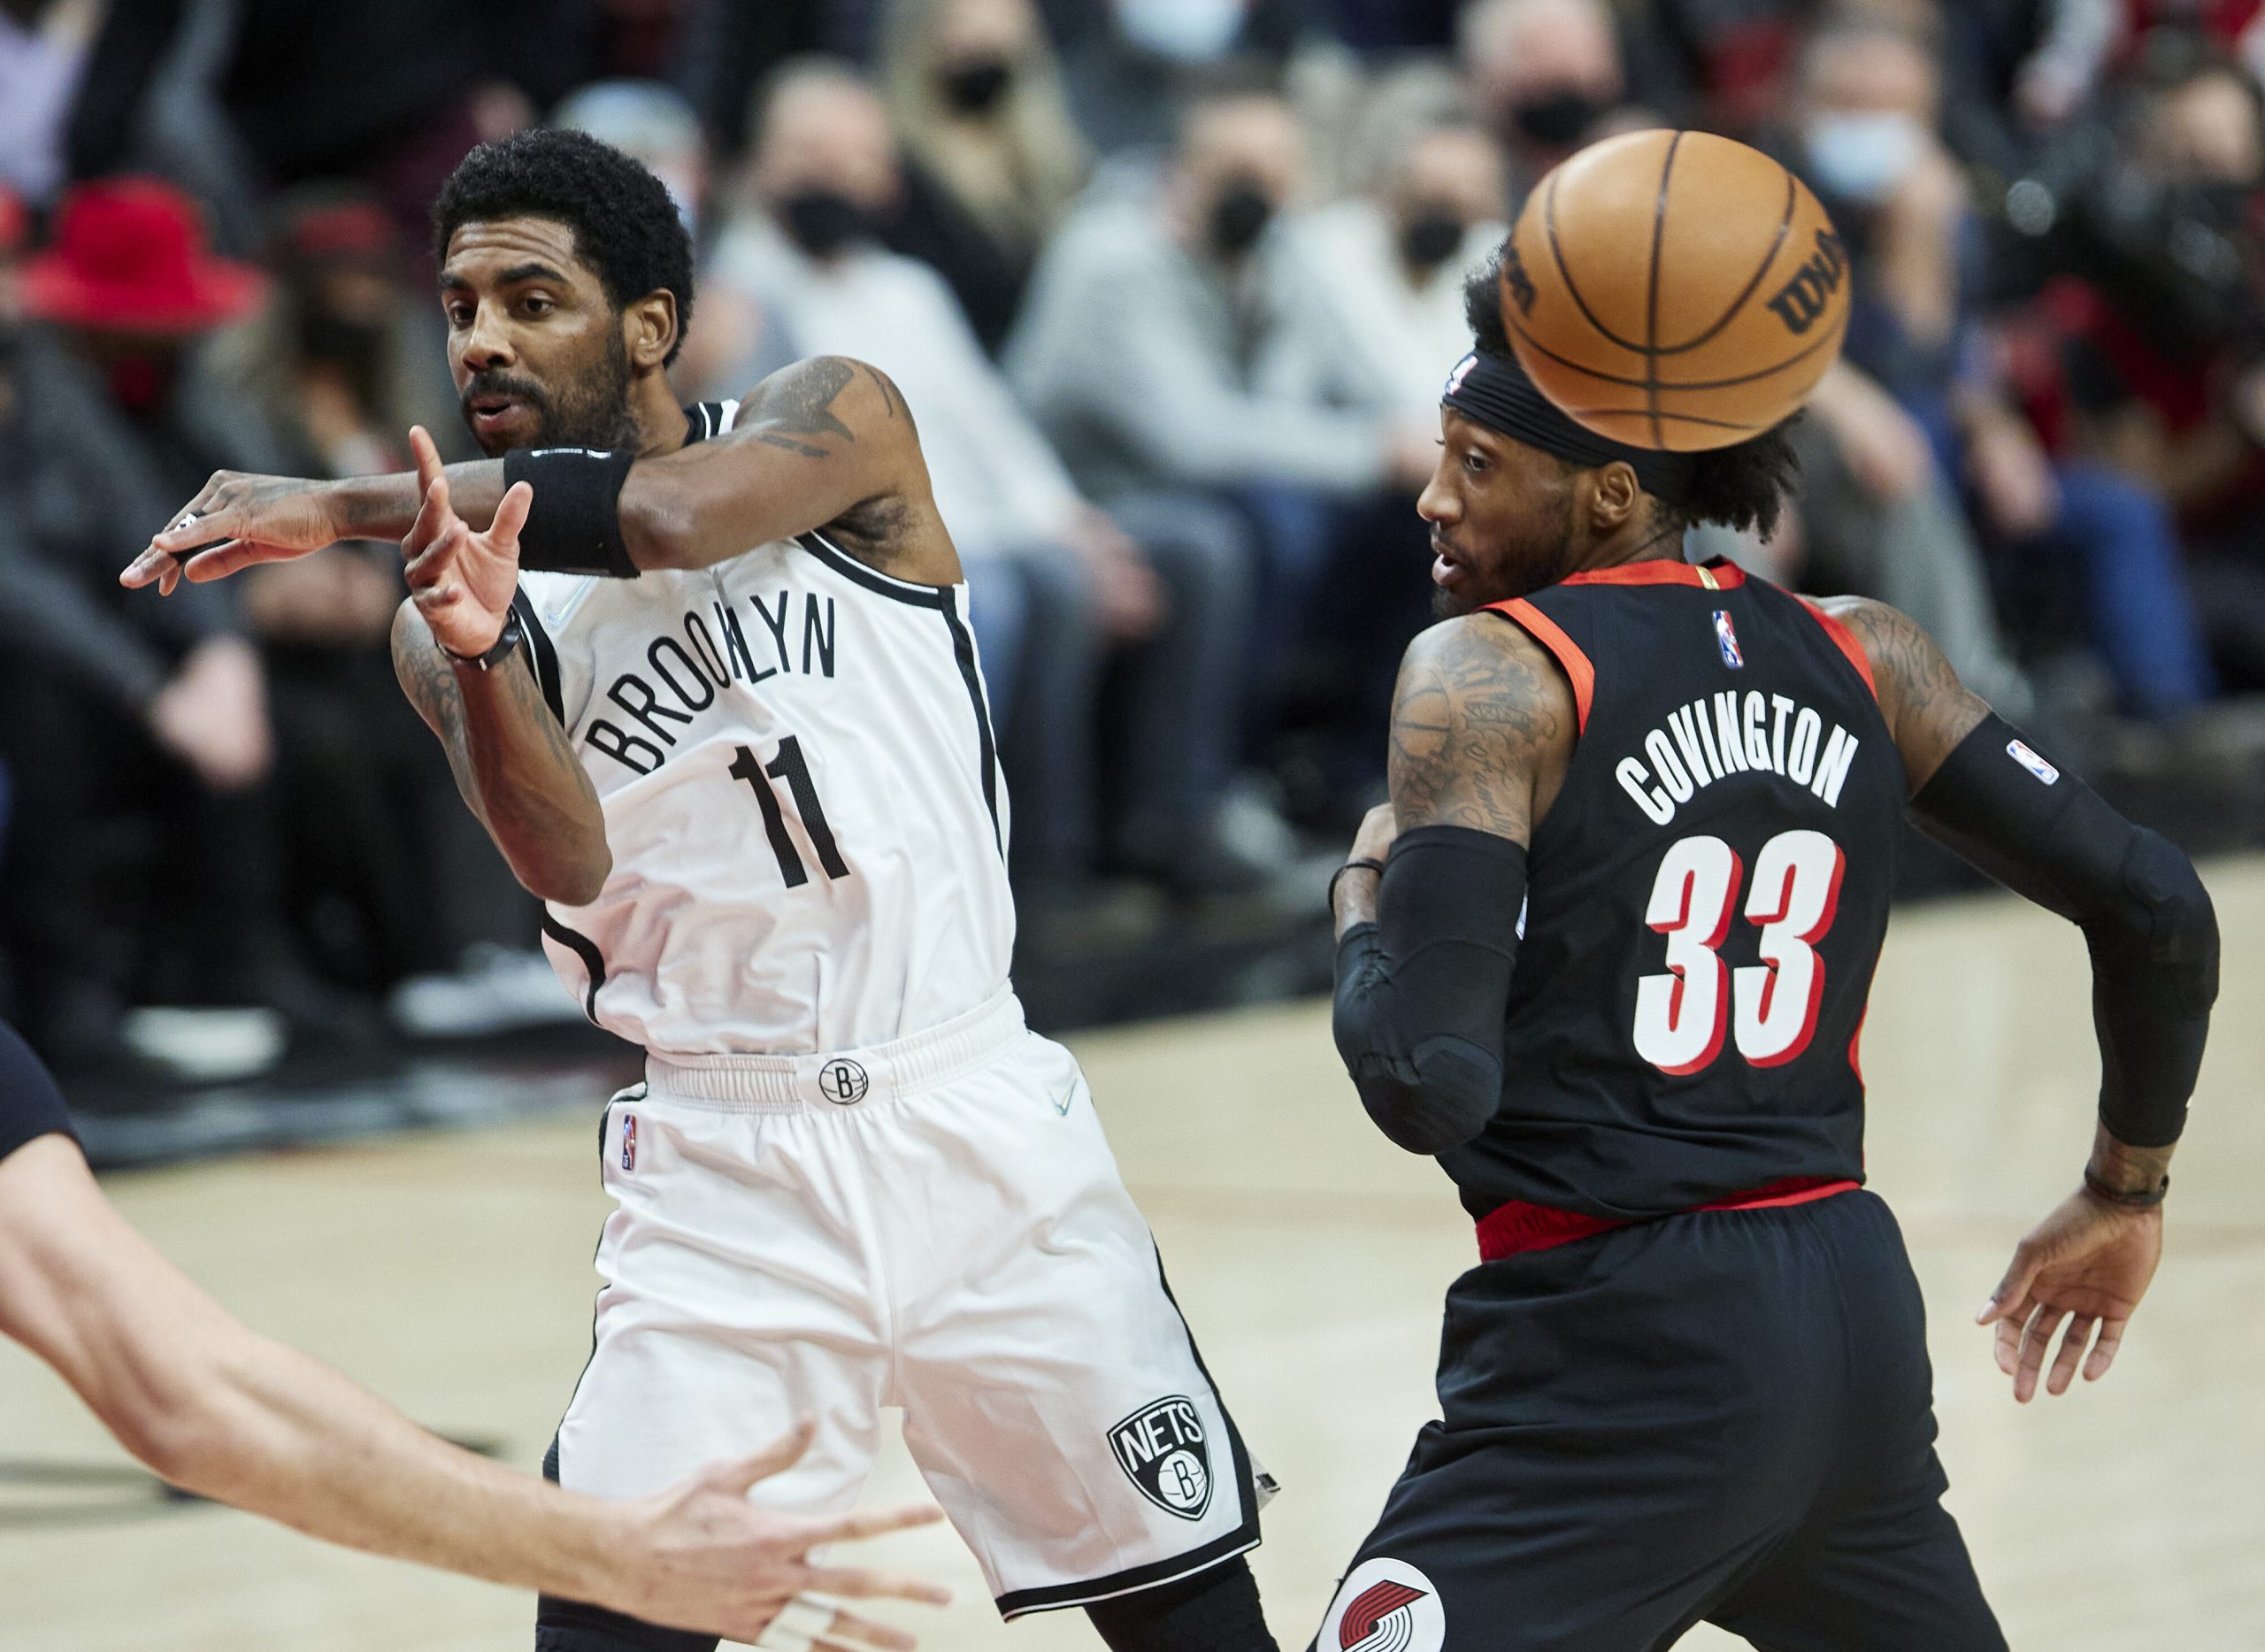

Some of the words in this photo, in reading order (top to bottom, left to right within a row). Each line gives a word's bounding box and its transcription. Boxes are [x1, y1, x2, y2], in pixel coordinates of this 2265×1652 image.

[585, 590, 834, 775] BROOKLYN
[728, 734, 849, 888] 11
[1616, 690, 1859, 826] COVINGTON
[1633, 830, 1846, 1076] 33
[835, 1066, 853, 1099] B
[1119, 1402, 1203, 1473] NETS
[1173, 1460, 1196, 1501] B
